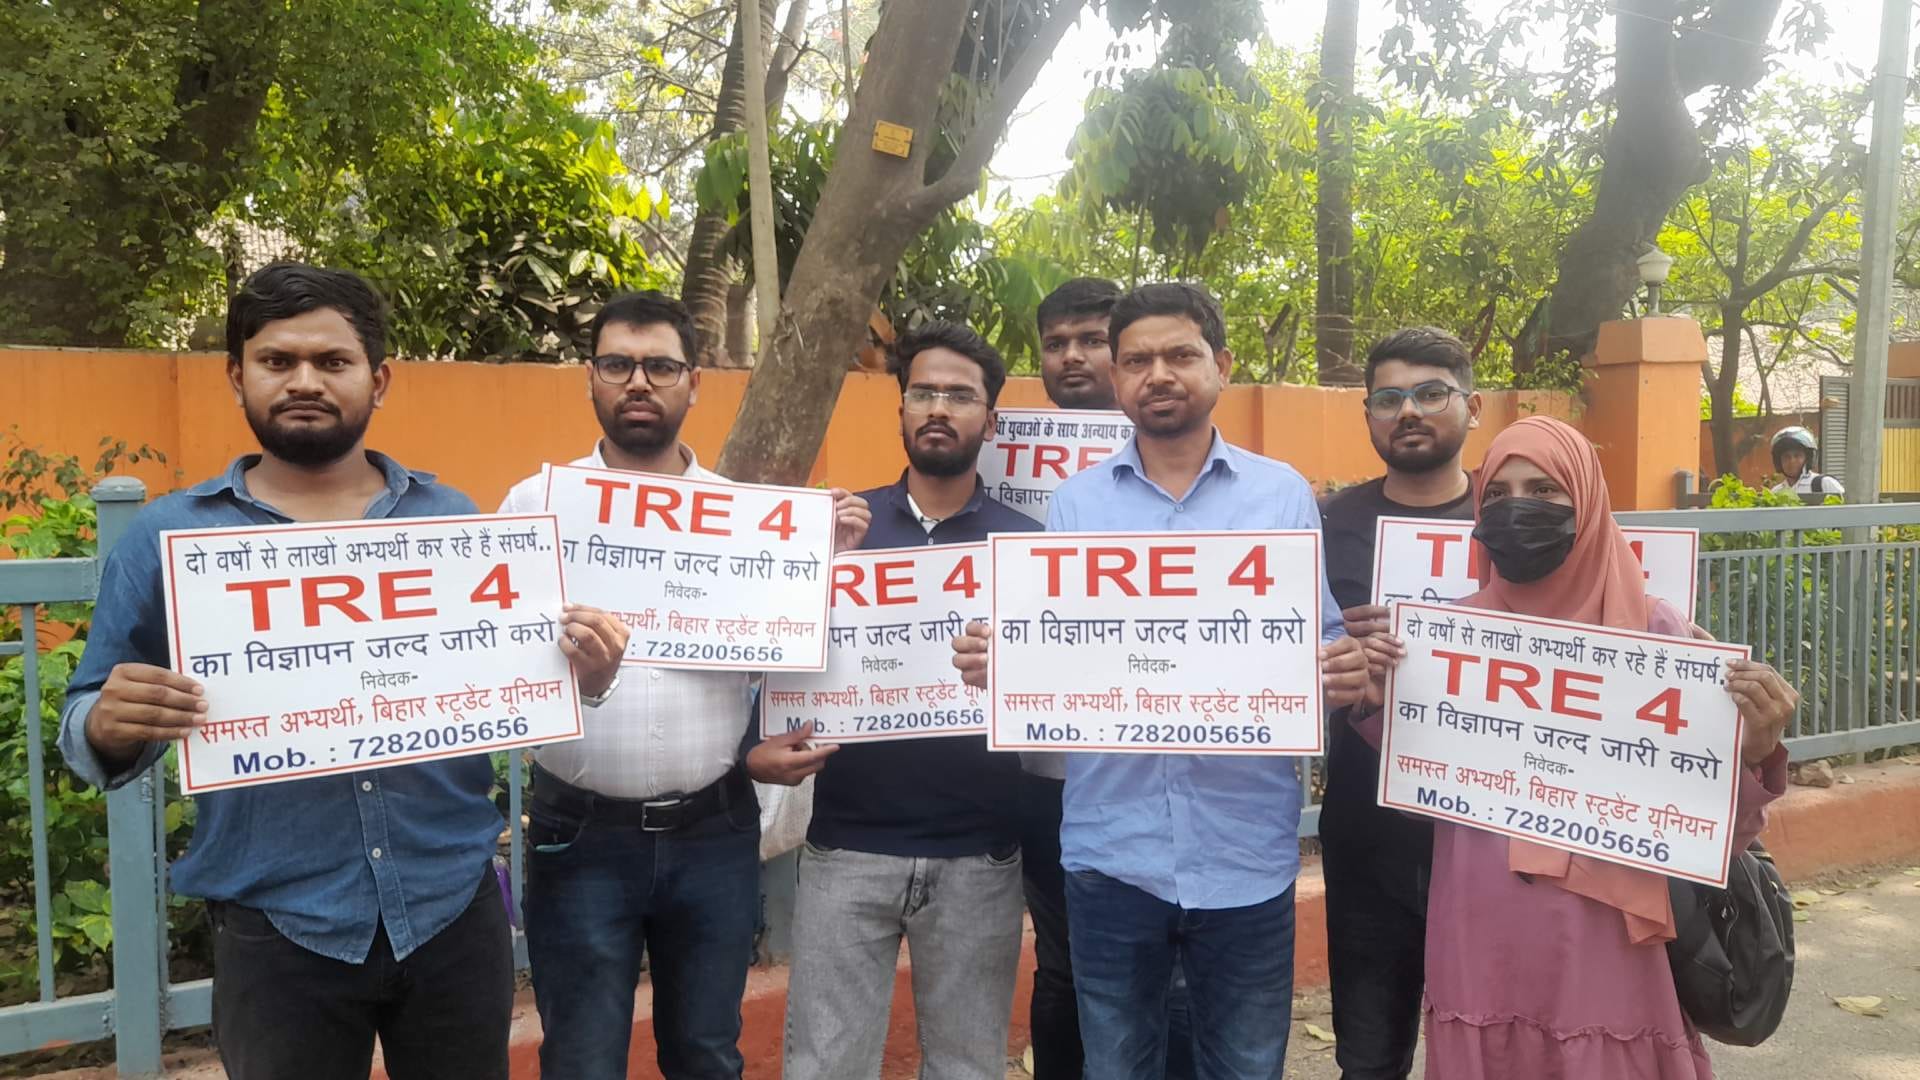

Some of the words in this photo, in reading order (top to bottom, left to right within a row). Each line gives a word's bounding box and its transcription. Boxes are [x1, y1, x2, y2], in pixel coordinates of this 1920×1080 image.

[1009, 417, 1041, 441] युवाओं
[1044, 418, 1055, 437] के
[586, 478, 734, 536] TRE
[758, 500, 798, 540] 4
[185, 545, 207, 574] दो
[217, 540, 250, 572] वर्षों
[260, 546, 278, 569] से
[287, 536, 337, 567] लाखों
[346, 533, 409, 565] अभ्यर्थी
[417, 537, 444, 559] कर
[450, 534, 472, 559] रहे
[479, 528, 491, 557] हैं
[588, 534, 666, 571] विज्ञापन
[674, 551, 721, 576] जल्द
[729, 550, 775, 579] जारी
[783, 552, 820, 580] करो
[1030, 546, 1198, 597] TRE
[1228, 545, 1274, 595] 4
[226, 569, 438, 632] TRE
[470, 563, 519, 610] 4
[664, 581, 708, 599] निवेदक-
[831, 560, 918, 608] RE
[942, 555, 981, 598] 4
[190, 651, 231, 678] का
[245, 638, 355, 674] विज्ञापन
[366, 633, 429, 659] जल्द
[440, 620, 498, 651] जारी
[509, 612, 556, 646] करो
[668, 611, 708, 633] बिहार
[716, 614, 759, 642] स्टूडेंट
[766, 616, 816, 644] यूनियन
[866, 623, 911, 647] जल्द
[920, 611, 964, 642] जारी
[1002, 619, 1030, 644] का
[1040, 610, 1125, 646] विज्ञापन
[1135, 619, 1188, 644] जल्द
[1198, 609, 1250, 644] जारी
[1261, 608, 1306, 644] करो
[1407, 613, 1423, 639] दो
[1428, 616, 1455, 642] वर्षों
[1461, 620, 1475, 646] से
[1481, 626, 1522, 652] लाखों
[1529, 637, 1586, 664] अभ्यर्थी
[1592, 645, 1618, 667] कर
[1625, 645, 1647, 675] रहे
[1654, 648, 1667, 679] हैं
[646, 641, 783, 662] 7282005656
[862, 656, 903, 673] निवेदक-
[1128, 654, 1176, 673] निवेदक-
[360, 669, 418, 690] निवेदक-
[770, 689, 806, 708] समस्त
[811, 685, 863, 708] अभ्यर्थी,
[870, 684, 909, 706] बिहार
[915, 679, 958, 708] स्टूडेंट
[1431, 649, 1605, 722] TRE
[1635, 688, 1688, 736] 4
[199, 715, 269, 744] समस्त
[279, 698, 363, 734] अभ्यर्थी,
[372, 694, 426, 723] बिहार
[435, 681, 492, 723] स्टूडेंट
[499, 677, 563, 714] यूनियन
[786, 716, 831, 733] Mb.
[853, 709, 984, 731] 7282005656
[1004, 693, 1055, 712] समस्त
[1063, 687, 1128, 713] अभ्यर्थी,
[1136, 688, 1180, 713] बिहार
[1190, 688, 1240, 720] स्टूडेंट
[1248, 689, 1308, 722] यूनियन
[233, 749, 315, 775] Mob.
[348, 717, 529, 759] 7282005656
[1026, 723, 1088, 741] Mob.
[1115, 724, 1272, 743] 7282005656
[1398, 701, 1428, 722] का
[1437, 702, 1524, 741] विज्ञापन
[1534, 724, 1590, 754] जल्द
[1601, 738, 1659, 767] जारी
[1670, 748, 1722, 780] करो
[1523, 752, 1575, 776] निवेदक-
[1397, 754, 1448, 780] समस्त
[1455, 765, 1521, 796] अभ्यर्थी,
[1529, 776, 1578, 808] बिहार
[1585, 792, 1640, 826] स्टूडेंट
[1648, 806, 1717, 841] यूनियन
[1417, 787, 1477, 816] Mob.
[1504, 806, 1670, 863] 7282005656
